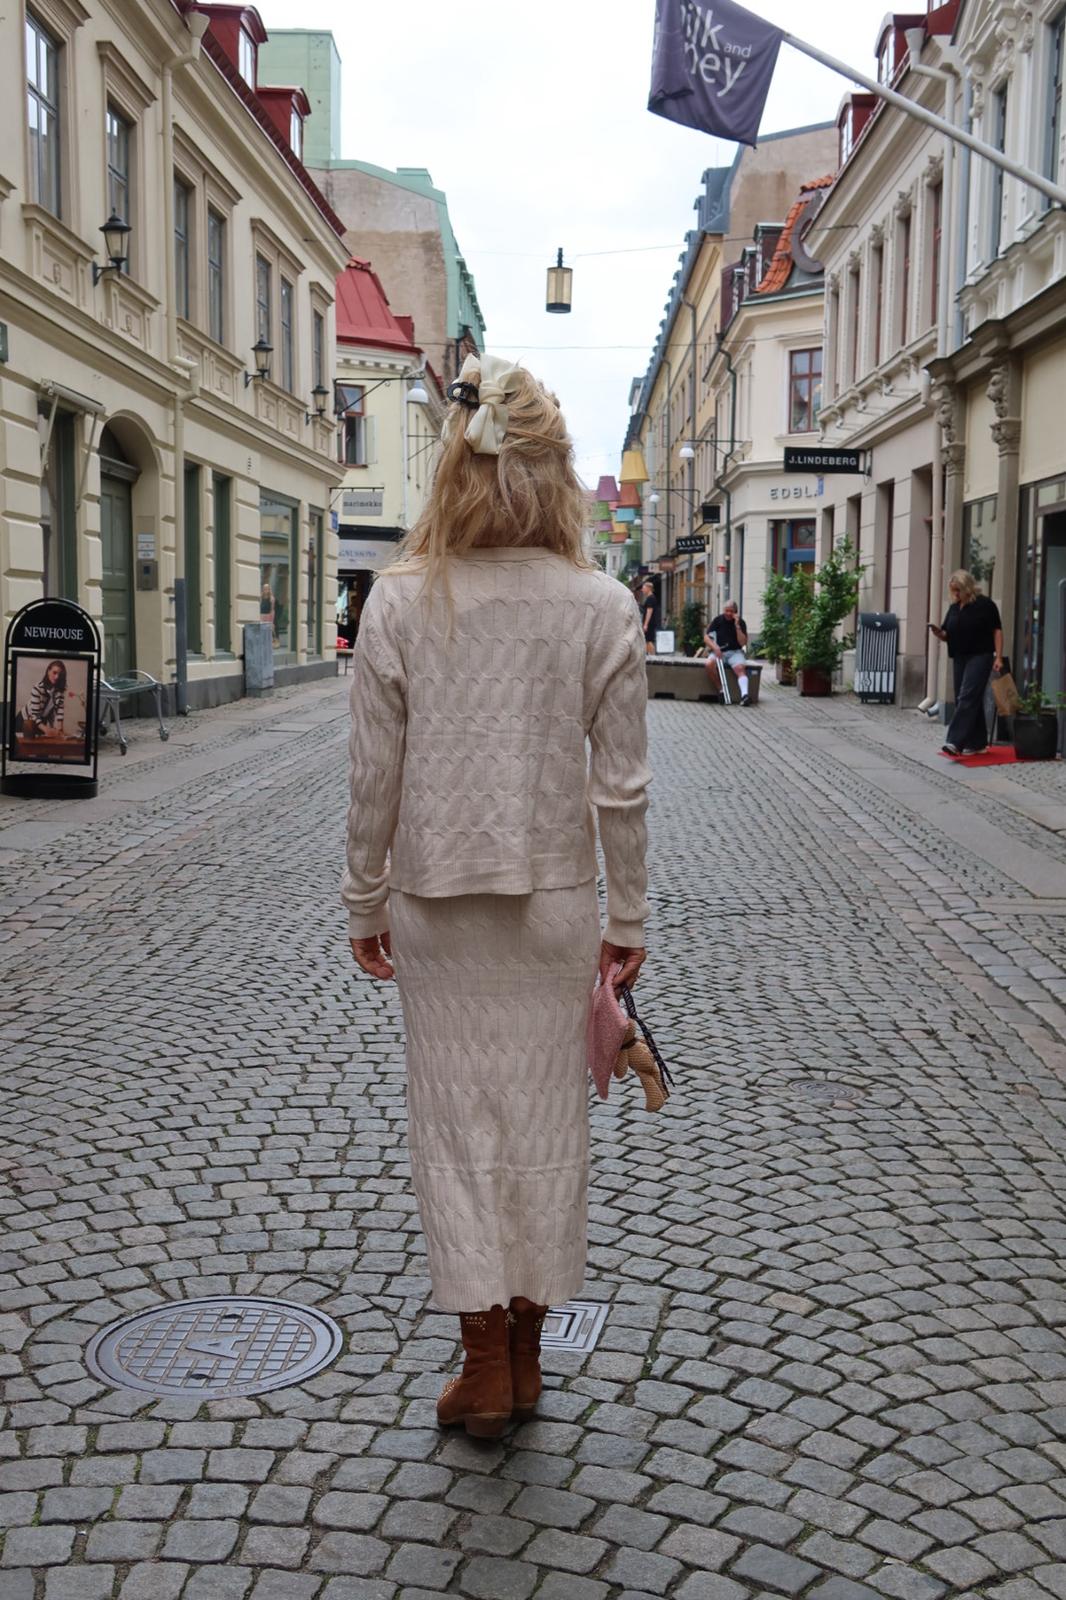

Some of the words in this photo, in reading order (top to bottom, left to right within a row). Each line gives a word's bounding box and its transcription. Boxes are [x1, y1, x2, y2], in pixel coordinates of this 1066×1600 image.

[724, 42, 752, 58] and
[789, 455, 857, 466] J.LINDEBERG
[769, 486, 818, 500] EDBL
[24, 626, 84, 640] NEWHOUSE
